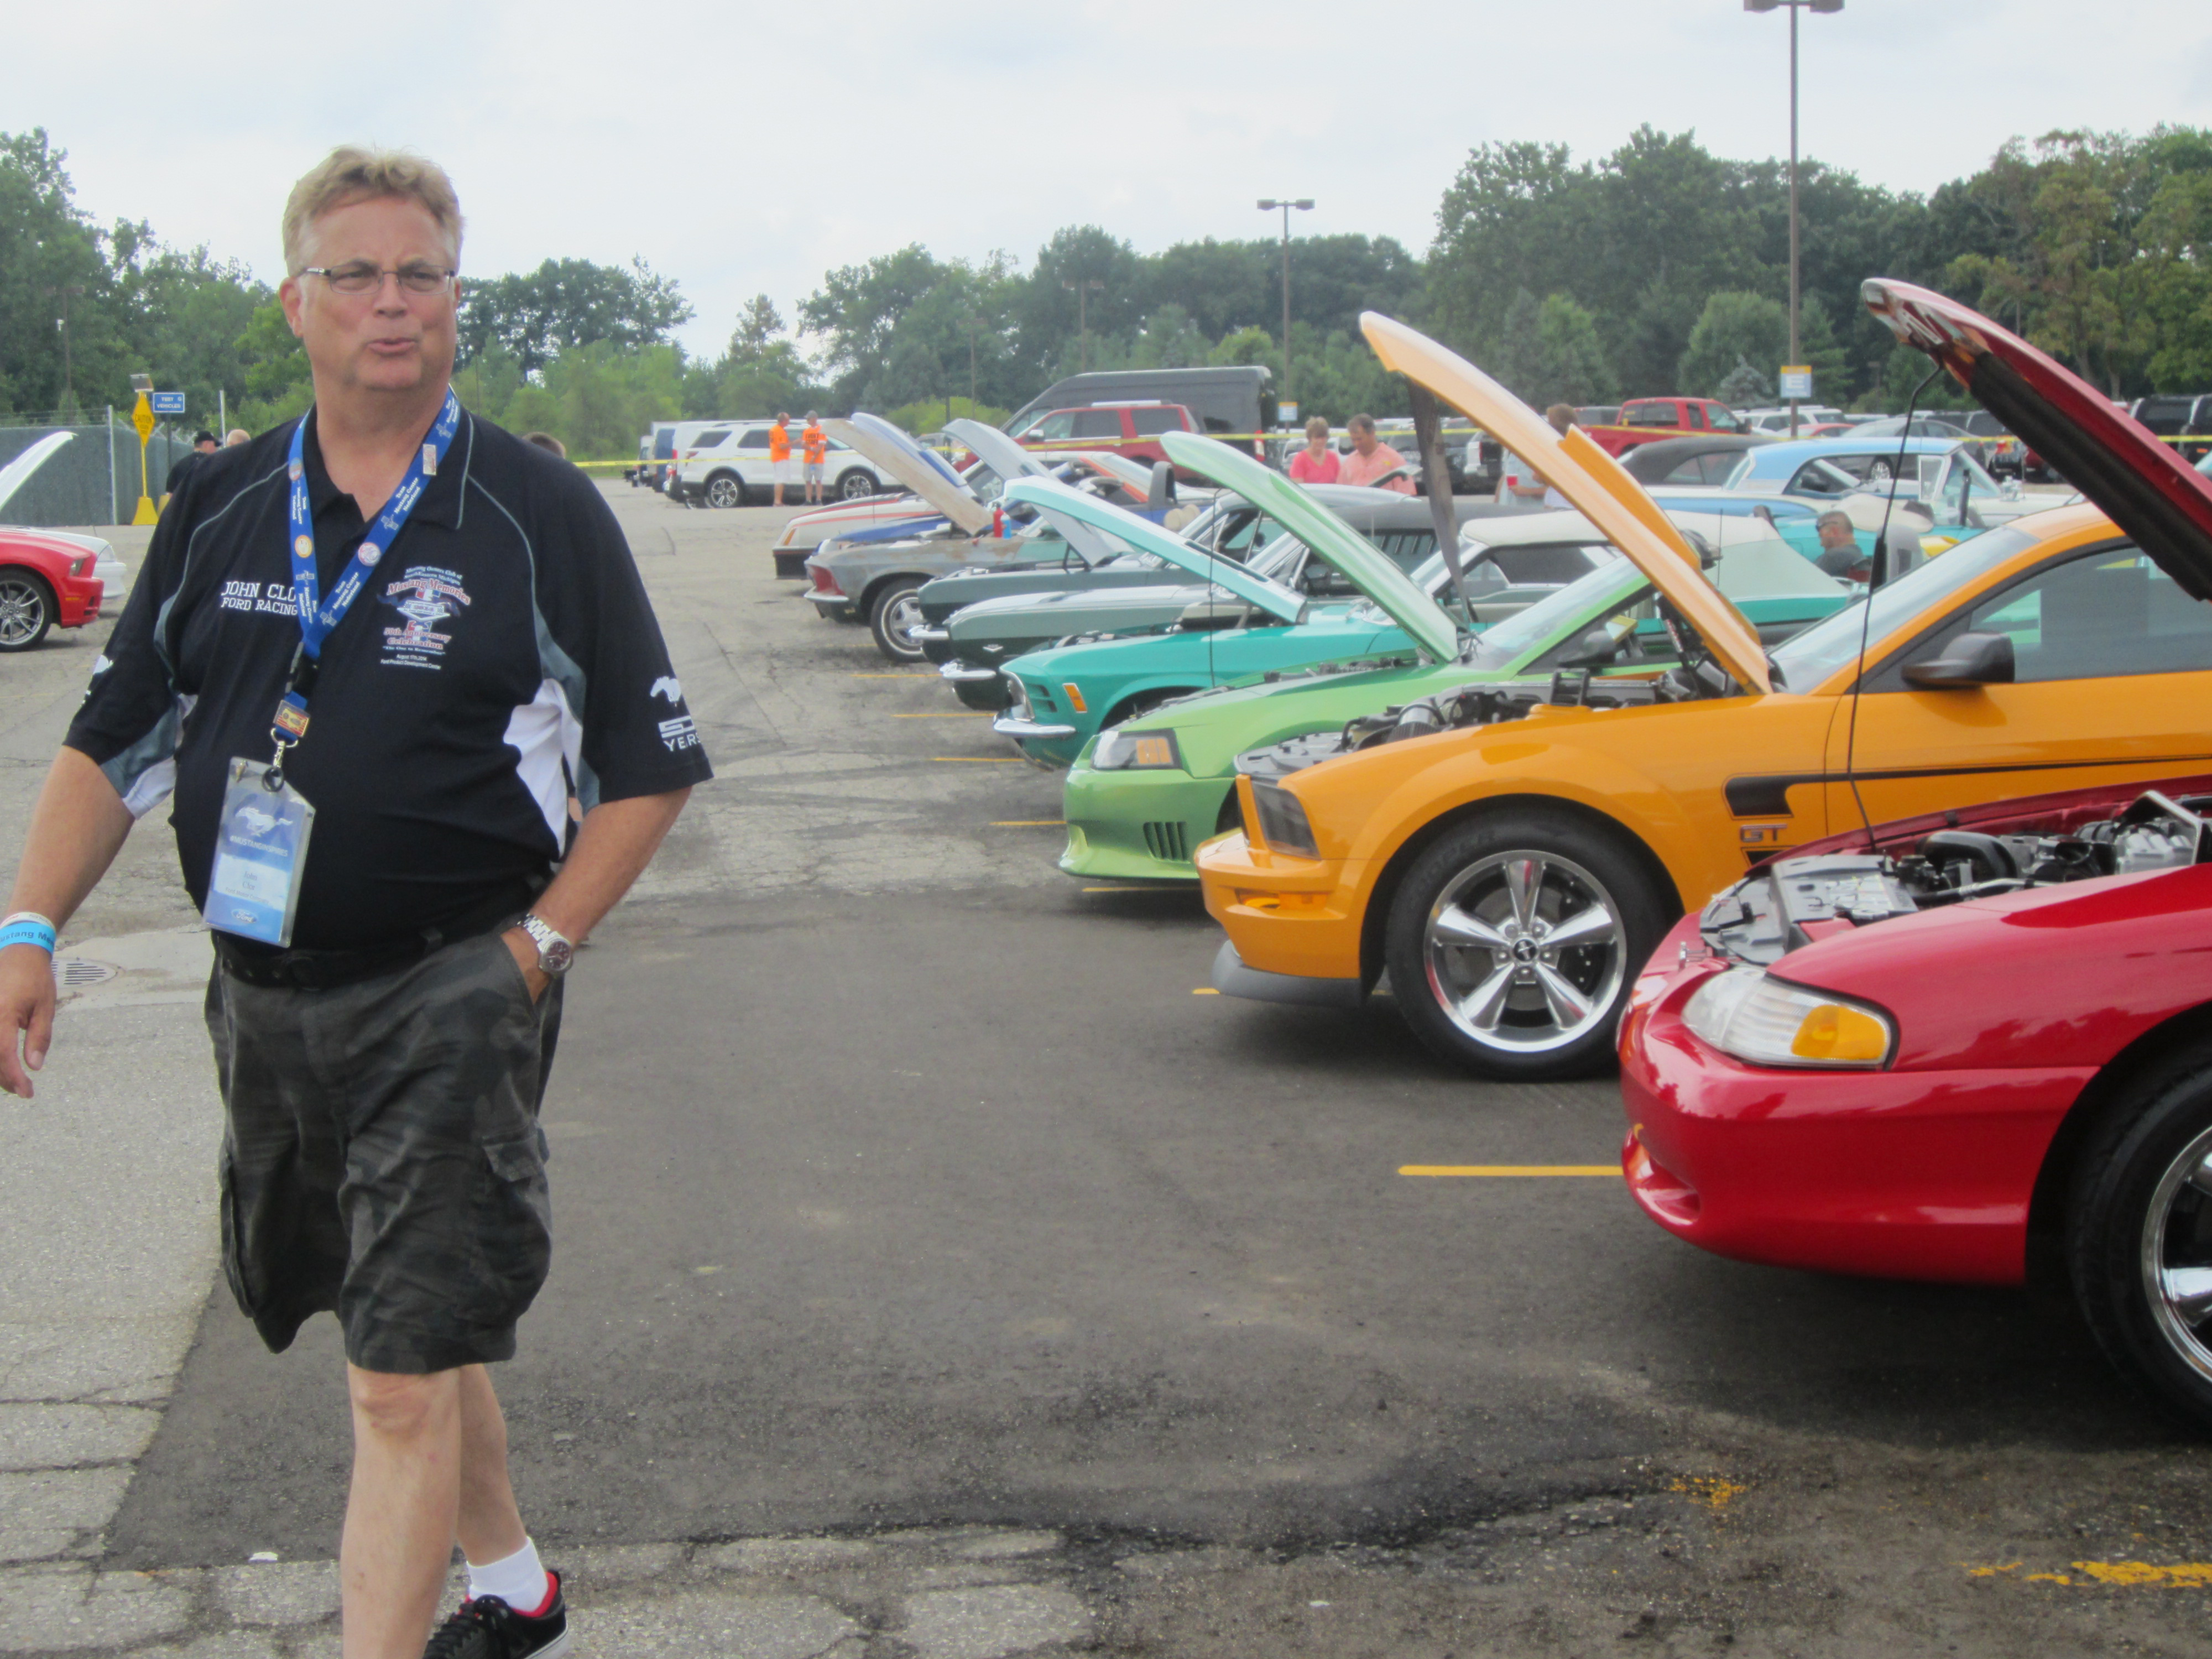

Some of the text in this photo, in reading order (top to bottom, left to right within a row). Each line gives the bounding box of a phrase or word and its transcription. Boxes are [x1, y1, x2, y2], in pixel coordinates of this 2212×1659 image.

[1786, 375, 1805, 388] E
[393, 477, 420, 514] Mustang Center
[395, 486, 406, 498] Team
[221, 581, 261, 597] JOHN
[332, 572, 359, 610] Mustang Center
[335, 581, 346, 593] Team
[386, 578, 472, 606] Mustang Memories
[221, 597, 298, 615] FORD RACING
[387, 637, 444, 650] Celebration
[402, 629, 452, 644] Anniversary
[1739, 823, 1787, 842] GT
[229, 836, 288, 857] #MUSTANGINSPIRES
[243, 870, 258, 881] John
[236, 910, 254, 923] Ford
